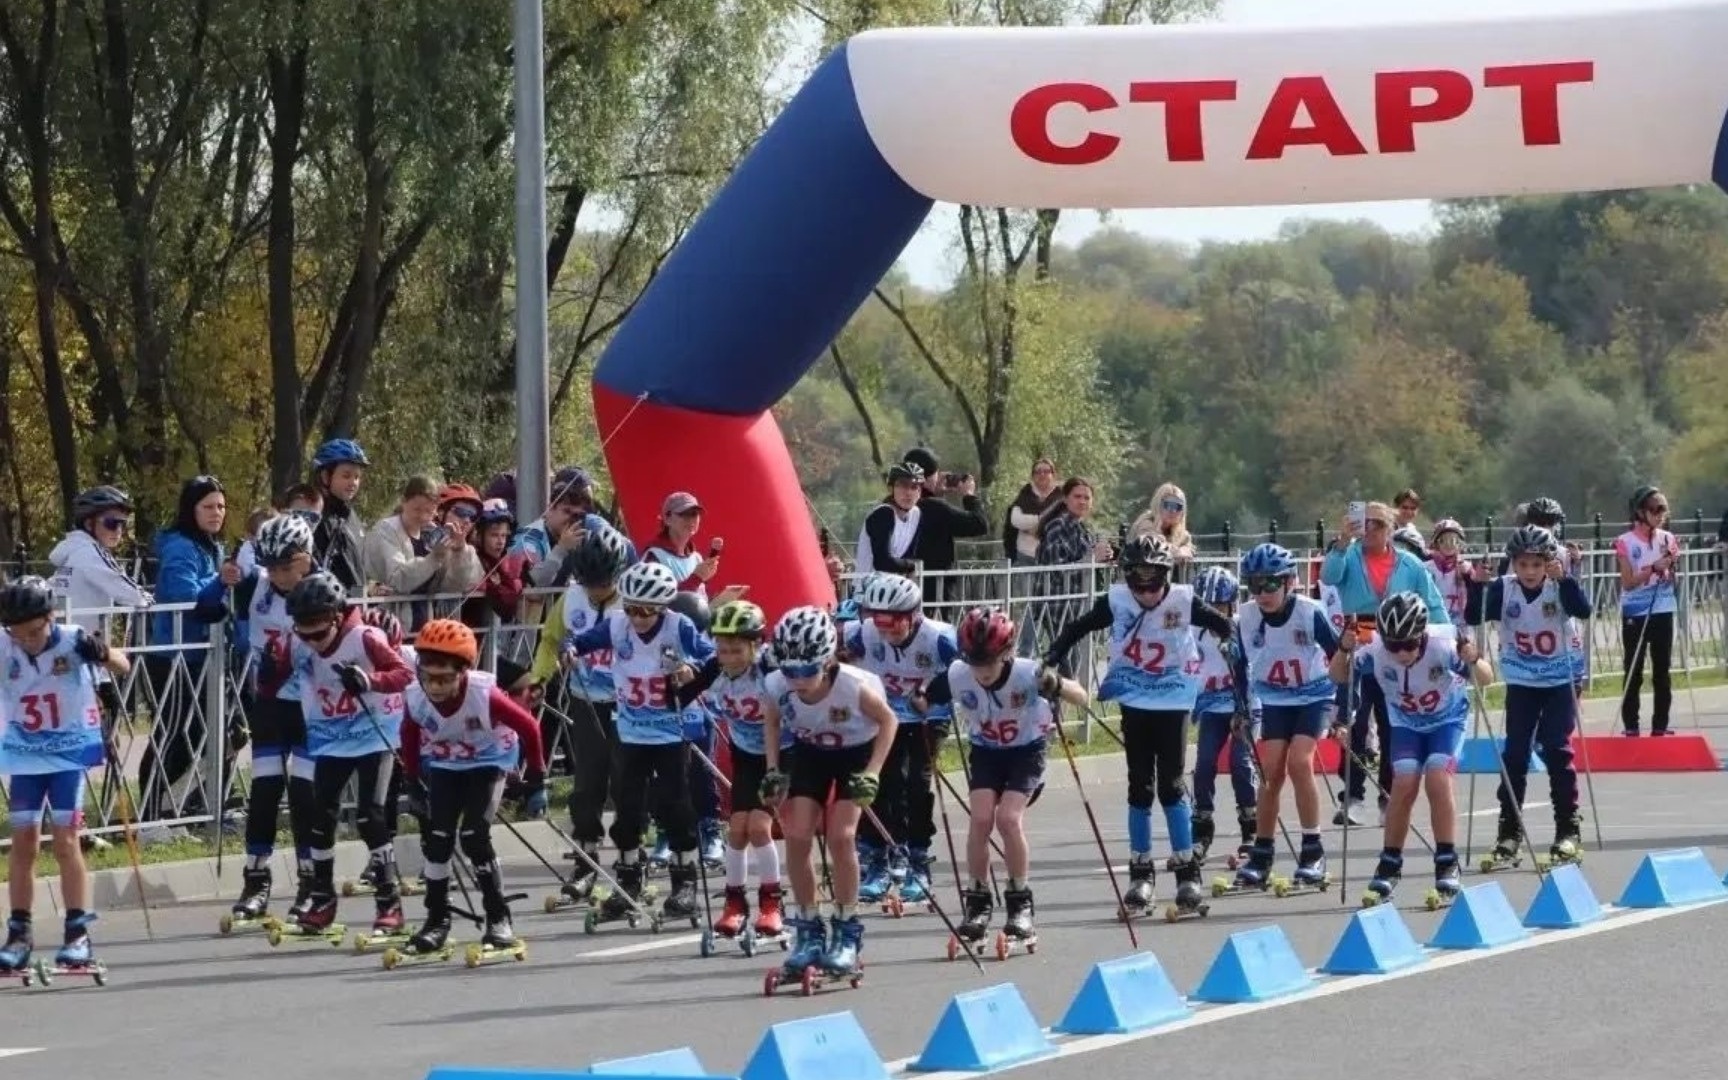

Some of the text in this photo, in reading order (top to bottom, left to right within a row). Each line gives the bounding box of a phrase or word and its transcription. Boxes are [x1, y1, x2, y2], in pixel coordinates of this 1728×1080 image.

[1011, 61, 1594, 165] СТАРТ
[1124, 638, 1165, 675] 42
[1515, 630, 1556, 655] 50
[885, 673, 924, 695] 37
[1267, 659, 1303, 687] 41
[317, 687, 359, 717] 34
[627, 676, 669, 708] 35
[1400, 690, 1441, 713] 39
[20, 693, 60, 731] 31
